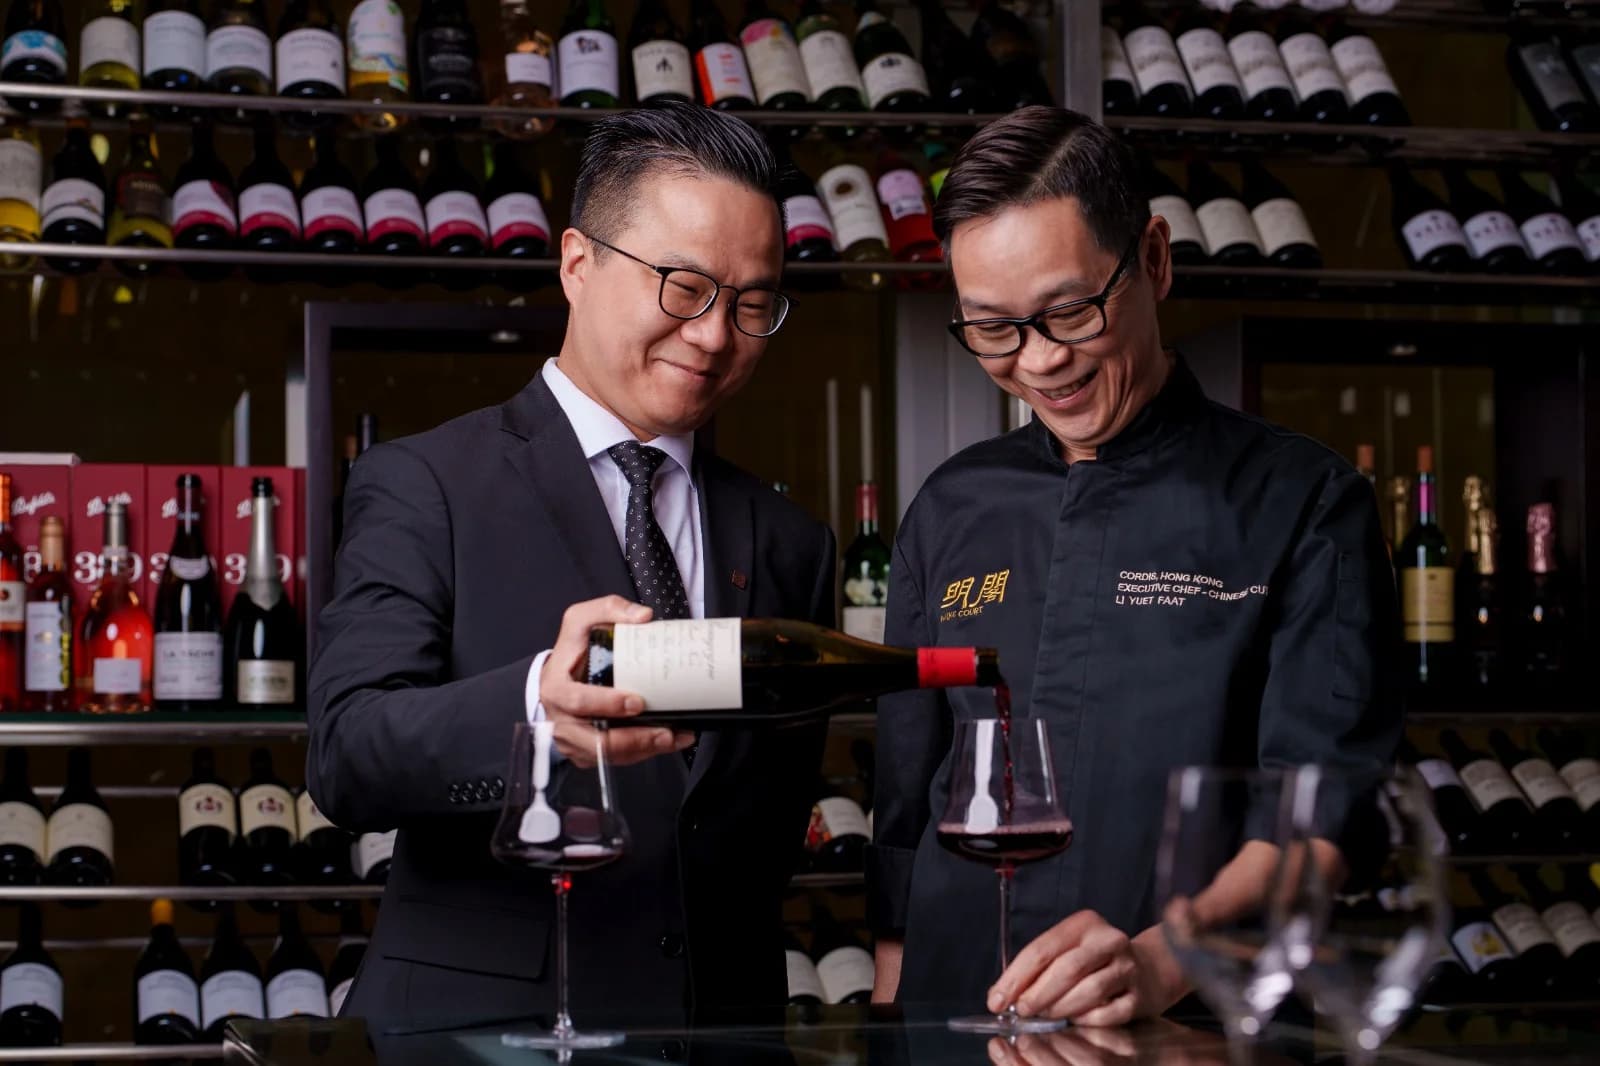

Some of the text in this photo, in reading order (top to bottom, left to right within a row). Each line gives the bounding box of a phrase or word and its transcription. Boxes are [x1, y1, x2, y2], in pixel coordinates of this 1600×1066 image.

[1119, 570, 1224, 588] CORDIS, HONG KONG
[1117, 583, 1171, 593] EXECUTIVE
[1172, 584, 1201, 595] CHEF
[1116, 595, 1187, 607] LI YUET FAAT
